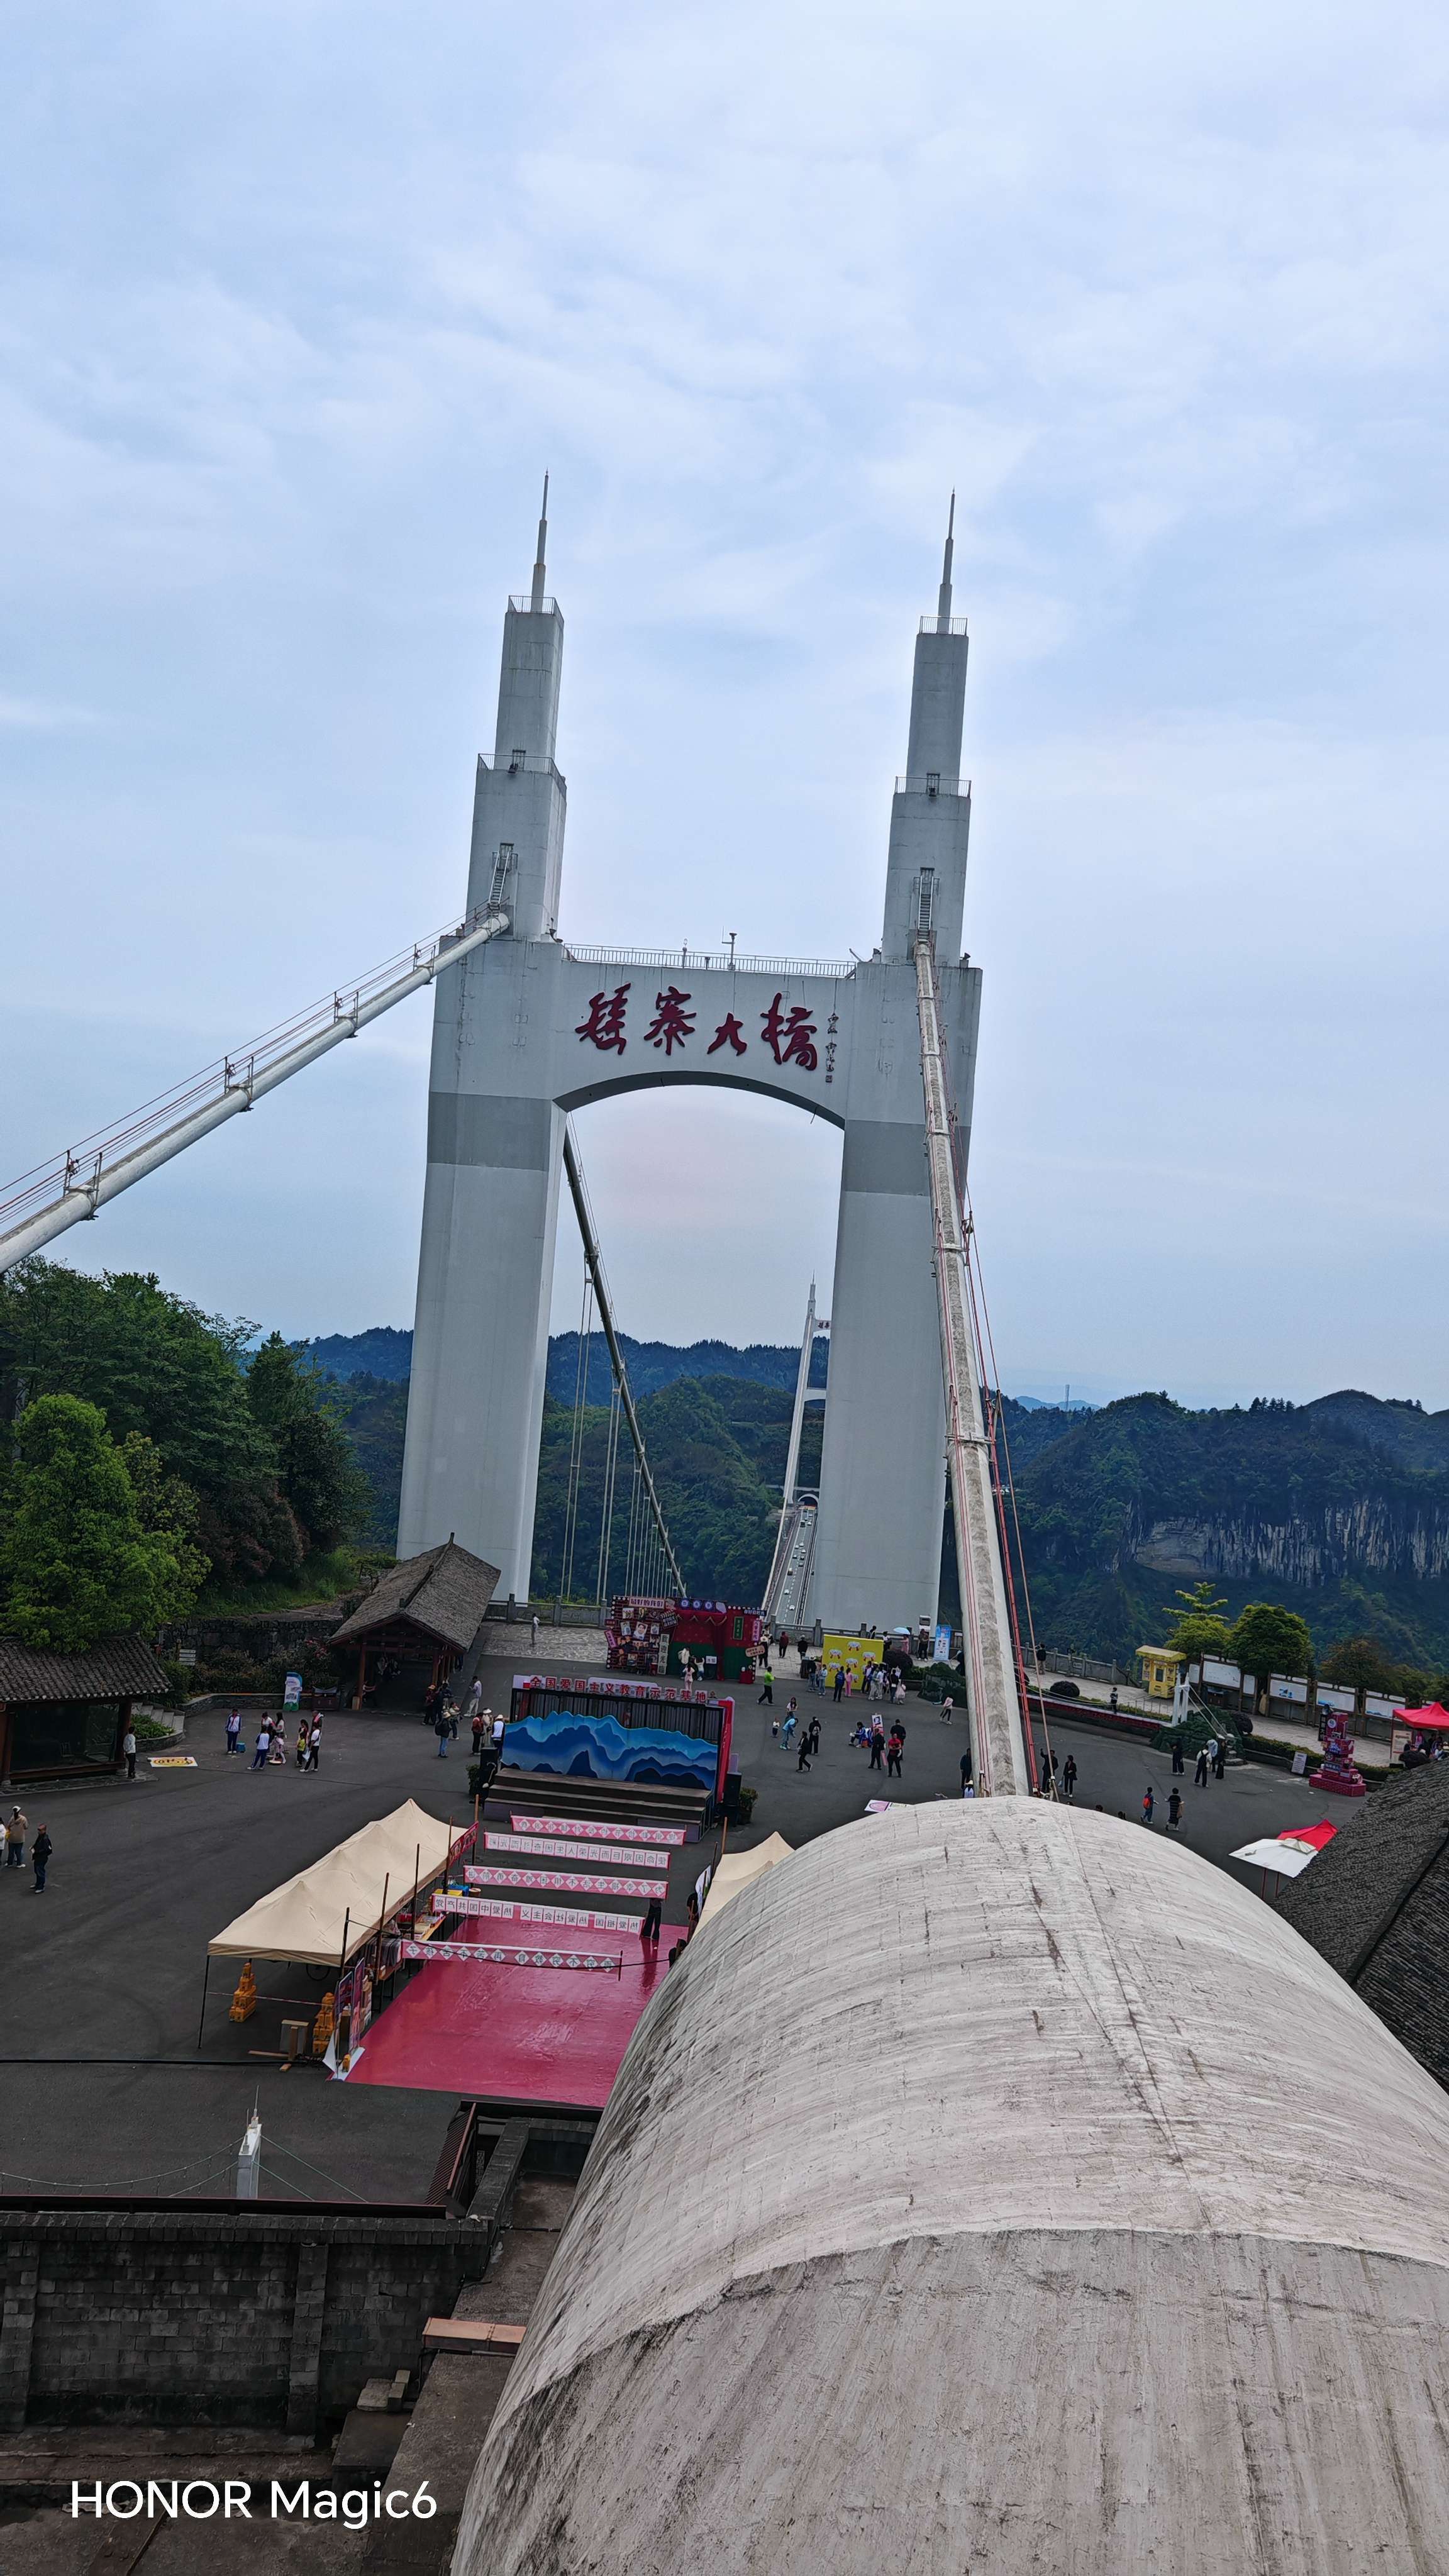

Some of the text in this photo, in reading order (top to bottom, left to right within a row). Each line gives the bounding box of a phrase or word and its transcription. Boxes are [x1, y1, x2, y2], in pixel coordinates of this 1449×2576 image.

[530, 1675, 707, 1703] 全国爱国主义教育示范基地
